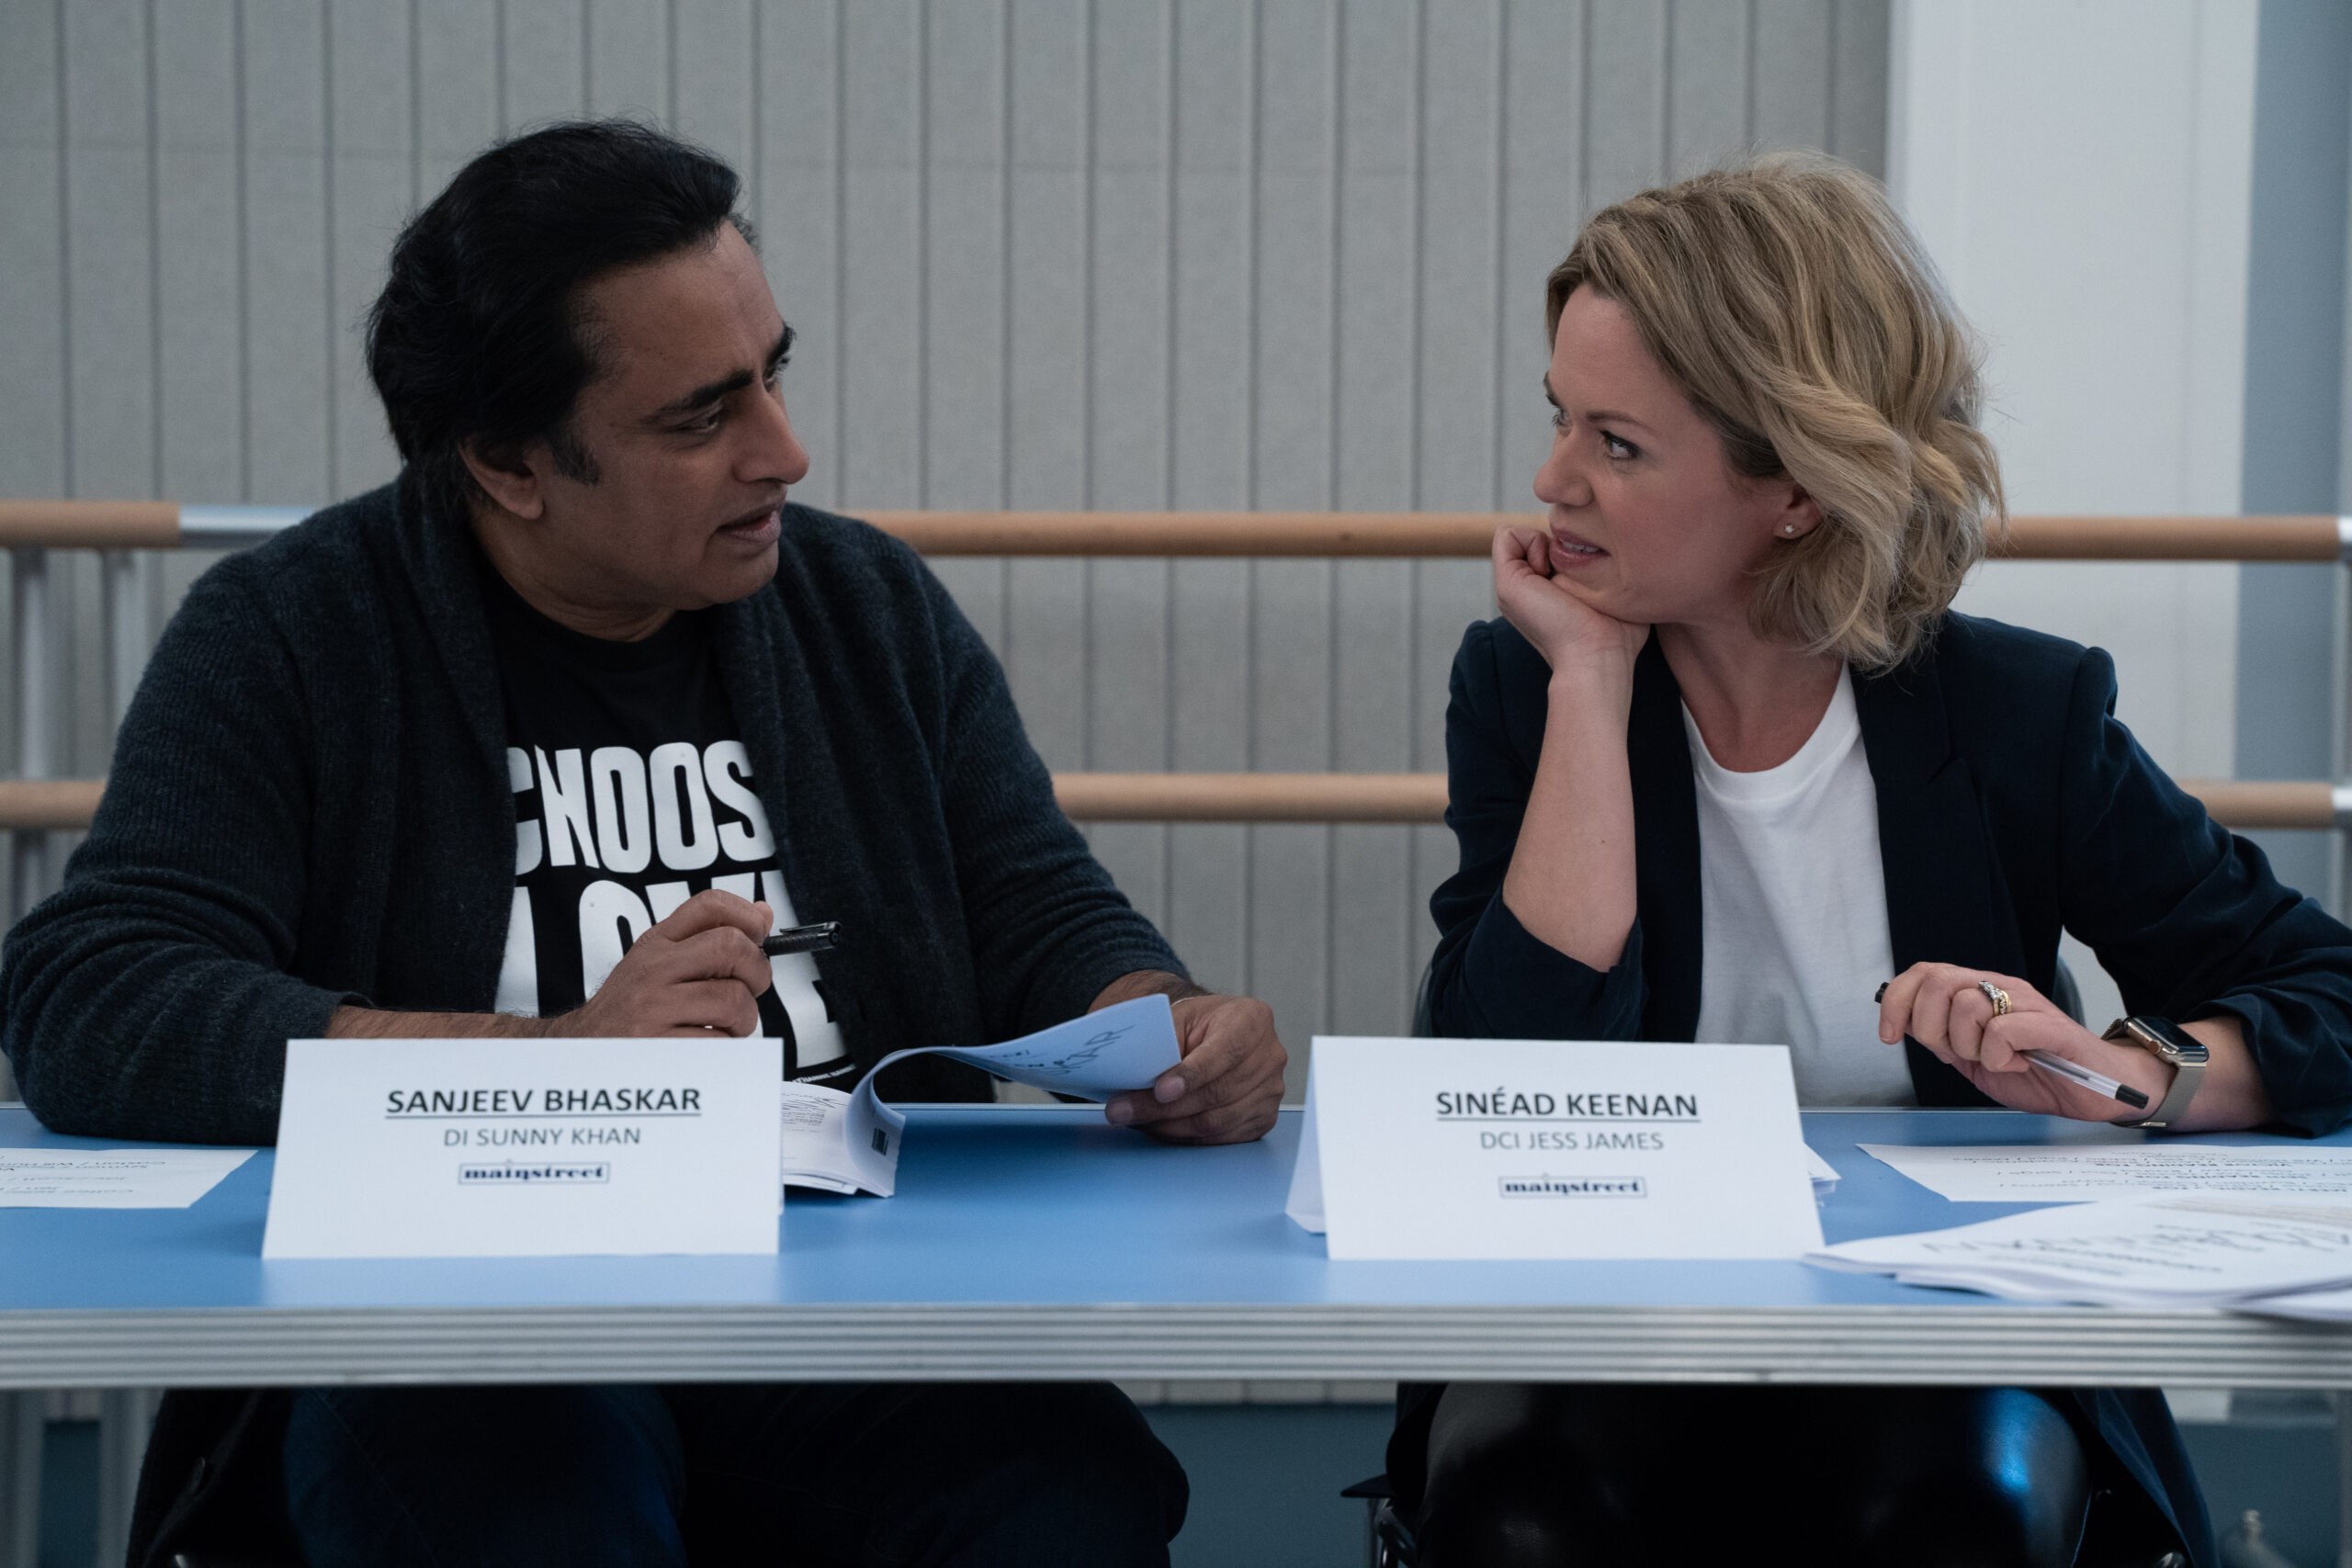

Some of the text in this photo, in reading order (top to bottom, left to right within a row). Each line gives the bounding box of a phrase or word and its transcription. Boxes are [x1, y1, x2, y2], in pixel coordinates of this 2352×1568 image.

[507, 739, 777, 877] CHOOS
[386, 1088, 701, 1114] SANJEEV BHASKAR
[1435, 1085, 1699, 1117] SINÉAD KEENAN
[443, 1127, 641, 1147] DI SUNNY KHAN
[1480, 1131, 1665, 1151] DCI JESS JAMES
[464, 1164, 604, 1182] mainstreet
[1504, 1178, 1641, 1196] mainstreet
